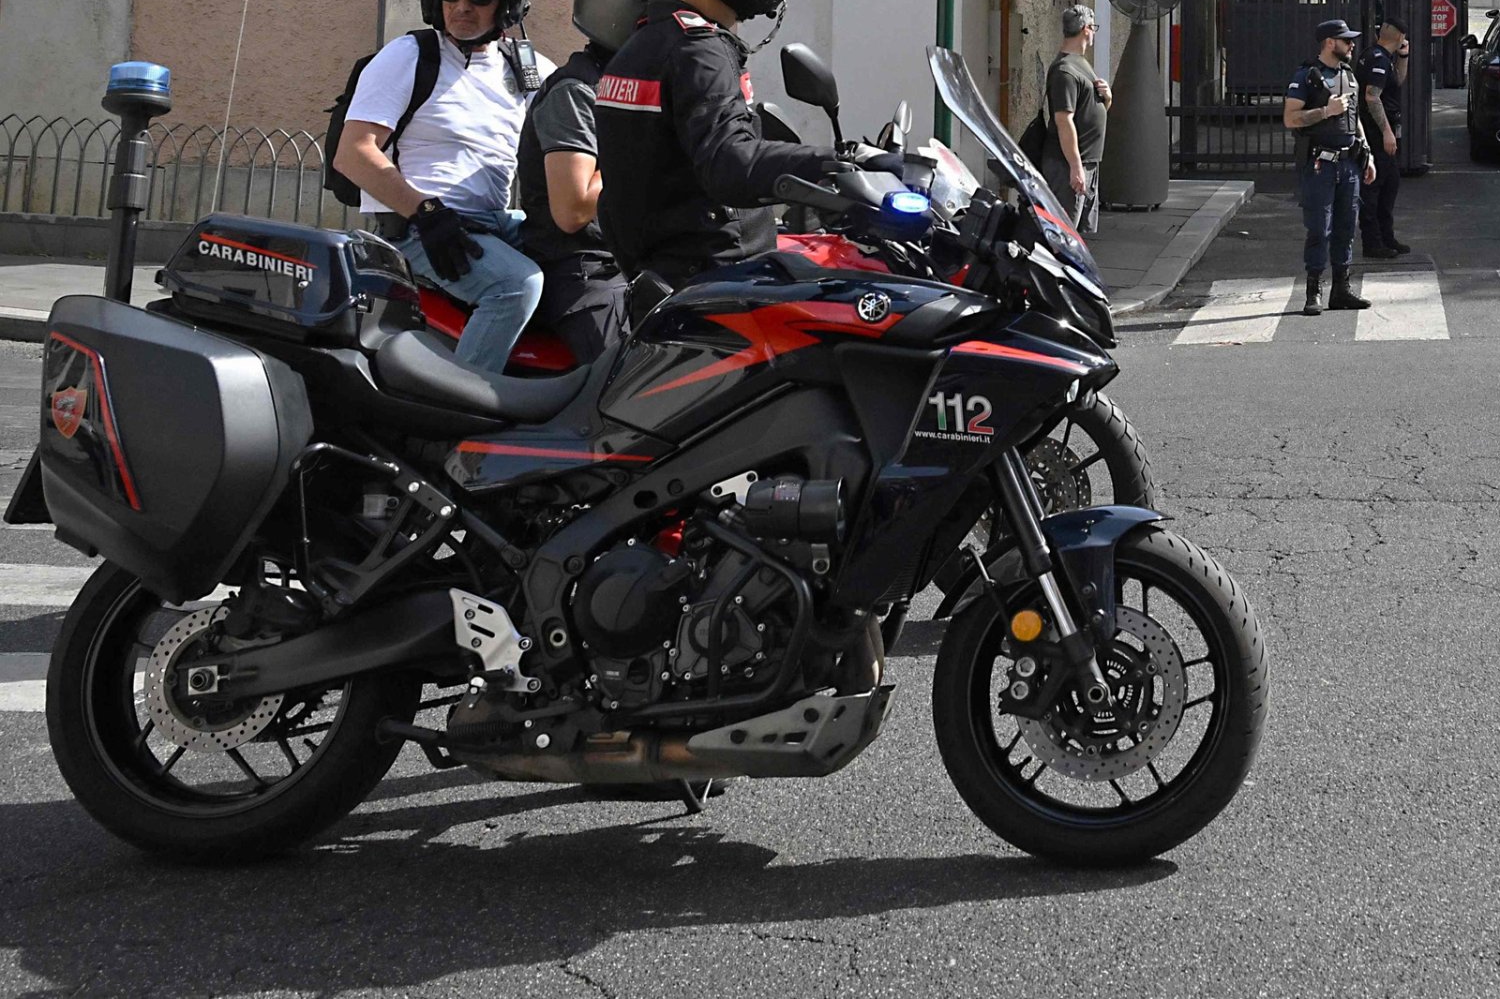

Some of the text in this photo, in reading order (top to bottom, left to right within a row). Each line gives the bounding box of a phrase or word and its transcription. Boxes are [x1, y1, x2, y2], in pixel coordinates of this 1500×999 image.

[1432, 13, 1448, 21] TOP
[1431, 22, 1448, 30] ERE
[198, 240, 313, 282] CARABINIERI
[928, 391, 994, 435] 112
[914, 430, 991, 444] www.carabinieri.it
